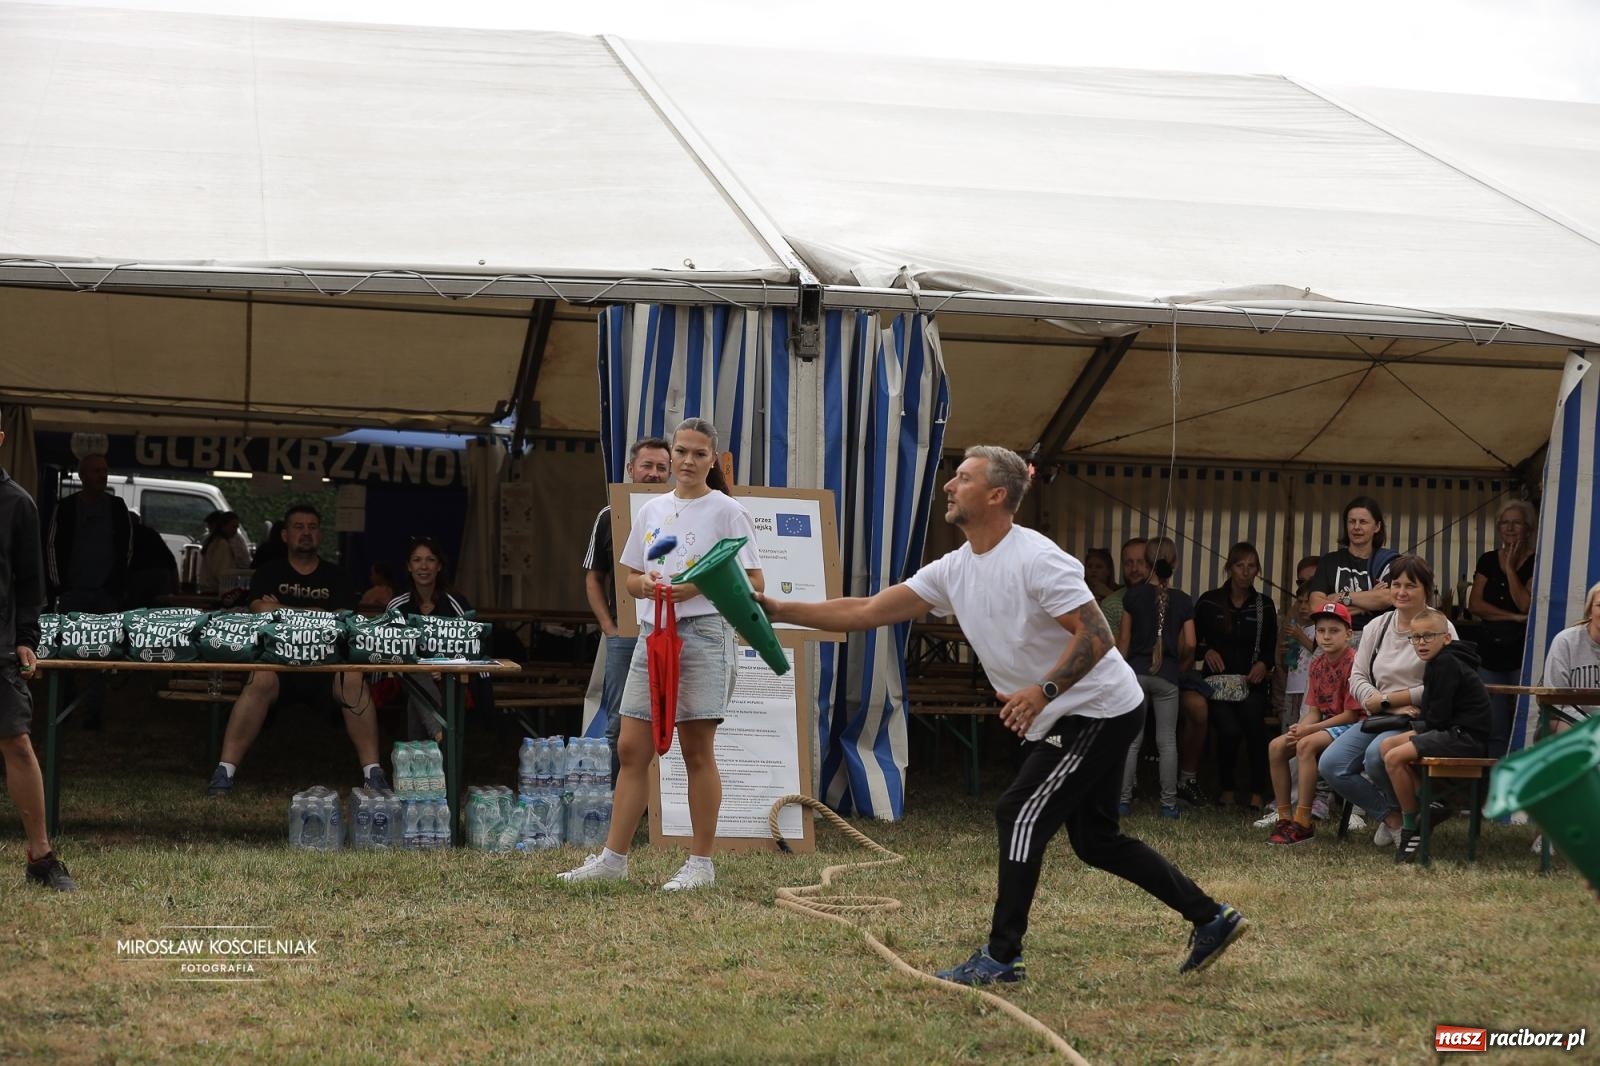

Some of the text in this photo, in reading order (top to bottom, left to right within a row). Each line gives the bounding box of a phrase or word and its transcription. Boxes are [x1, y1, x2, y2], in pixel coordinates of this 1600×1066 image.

[268, 438, 468, 487] KRZANO
[279, 583, 330, 599] adidas
[146, 624, 176, 637] MOC
[292, 630, 320, 645] MOC
[374, 626, 402, 639] MOC
[437, 626, 466, 639] MOC
